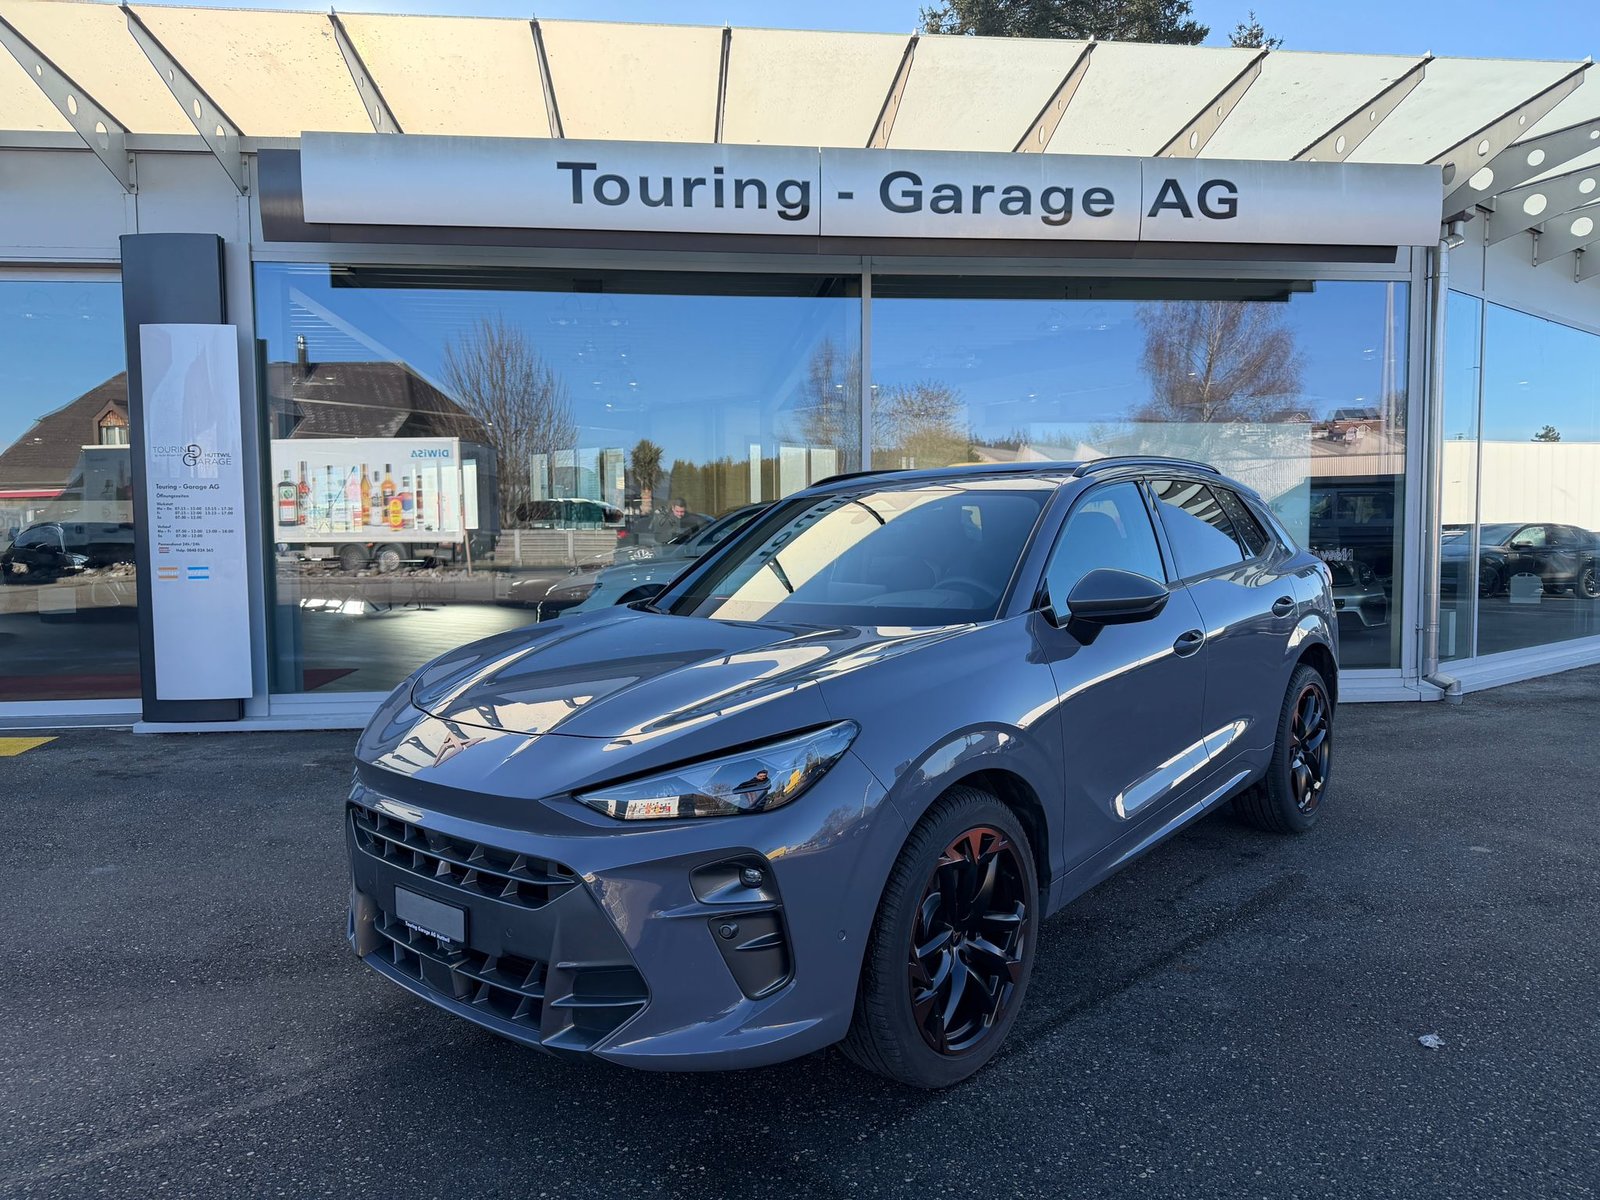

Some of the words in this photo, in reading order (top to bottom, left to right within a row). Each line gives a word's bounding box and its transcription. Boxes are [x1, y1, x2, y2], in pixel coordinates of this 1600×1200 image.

[556, 161, 811, 222] Touring
[837, 191, 854, 200] -
[879, 170, 1116, 227] Garage
[1147, 178, 1239, 220] AG
[156, 483, 178, 491] Touring
[183, 483, 208, 491] Garage
